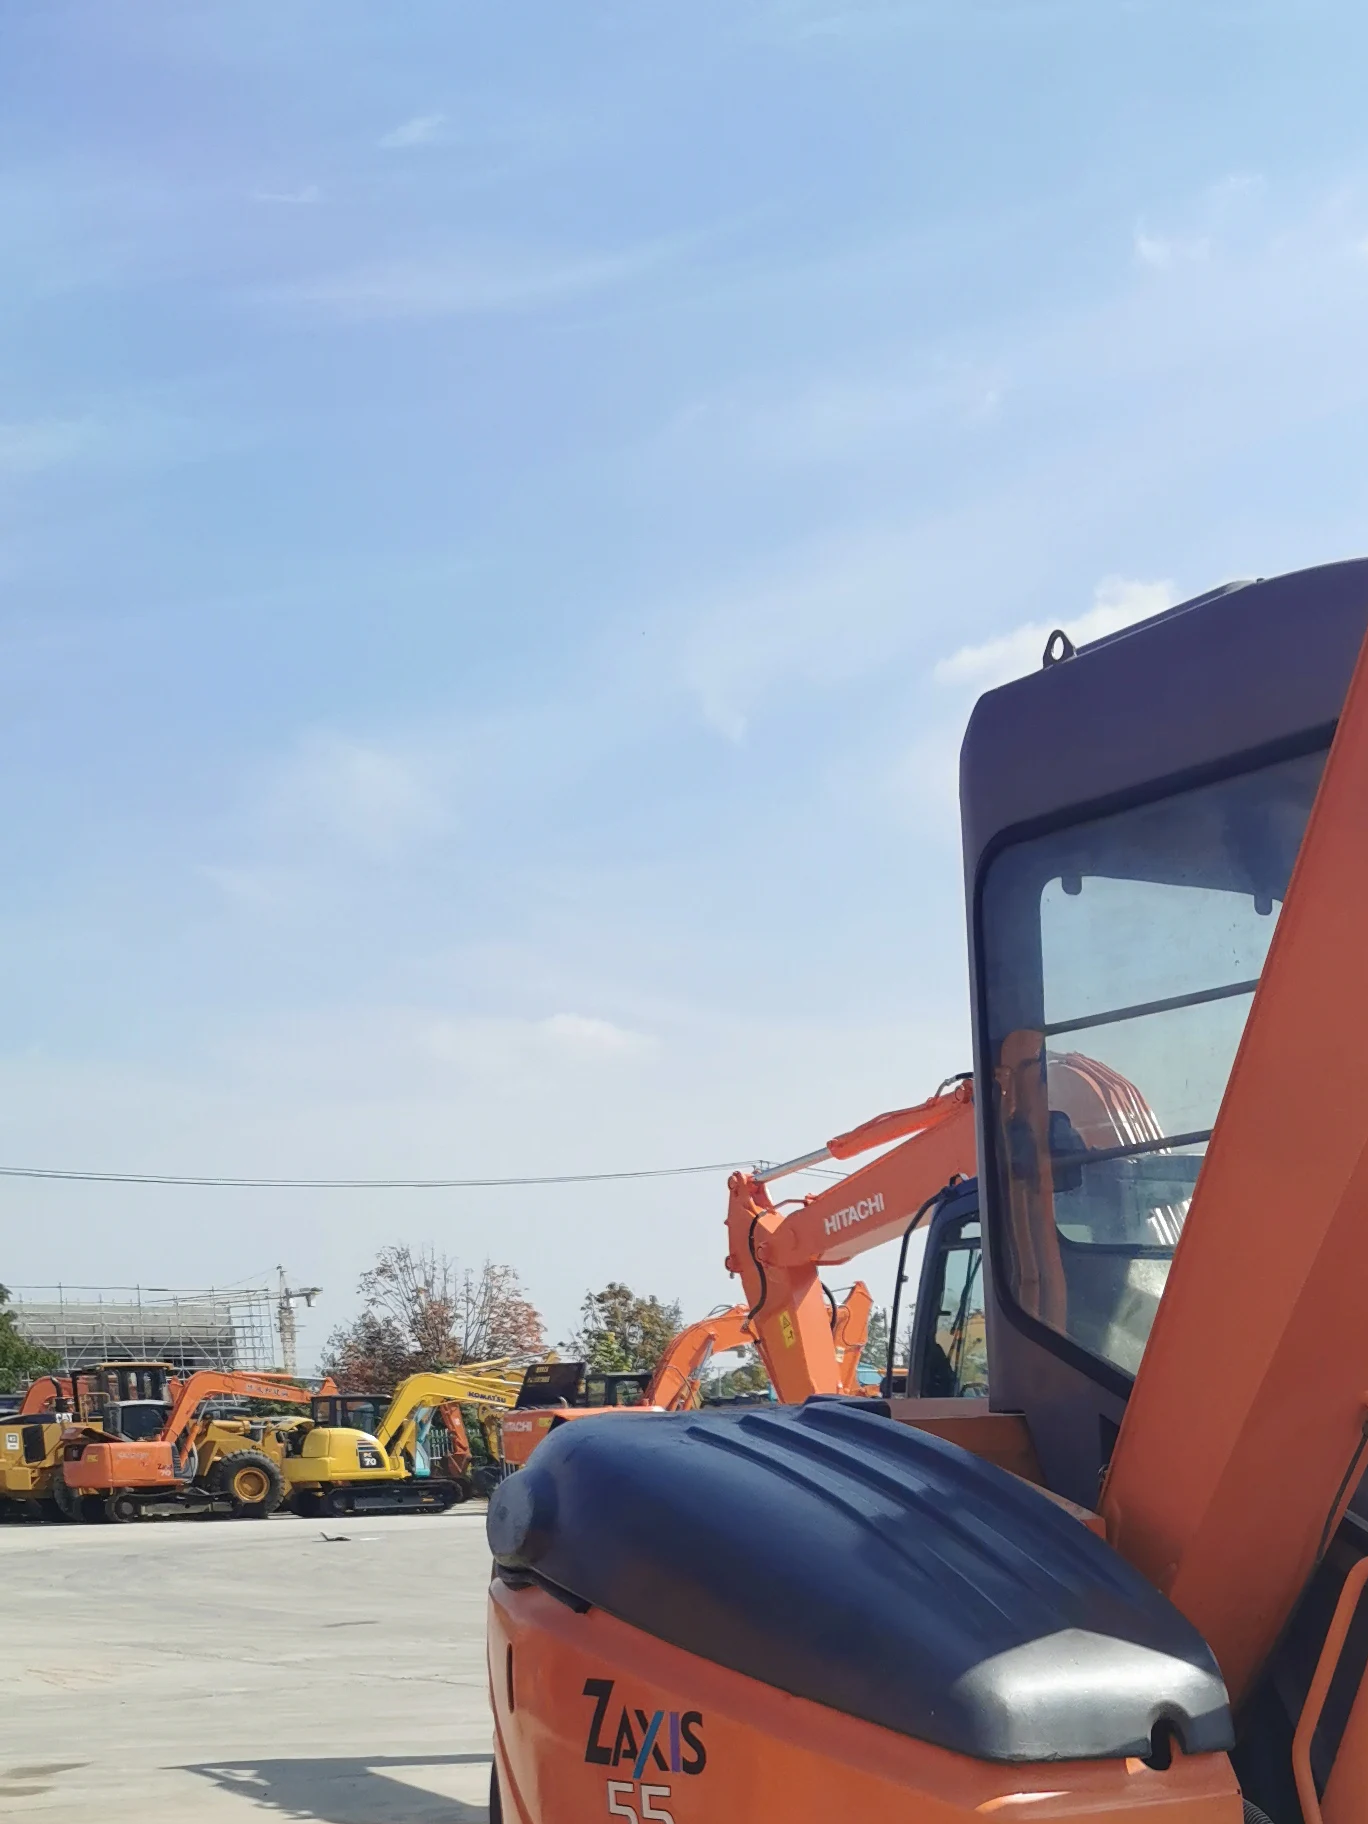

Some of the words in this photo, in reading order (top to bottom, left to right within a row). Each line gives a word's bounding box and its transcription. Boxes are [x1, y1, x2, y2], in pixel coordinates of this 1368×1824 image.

[823, 1192, 885, 1236] HITACHI
[467, 1391, 507, 1404] KOMATSU
[55, 1412, 74, 1424] CAT
[364, 1457, 377, 1466] 70
[582, 1678, 707, 1780] ZAXIS
